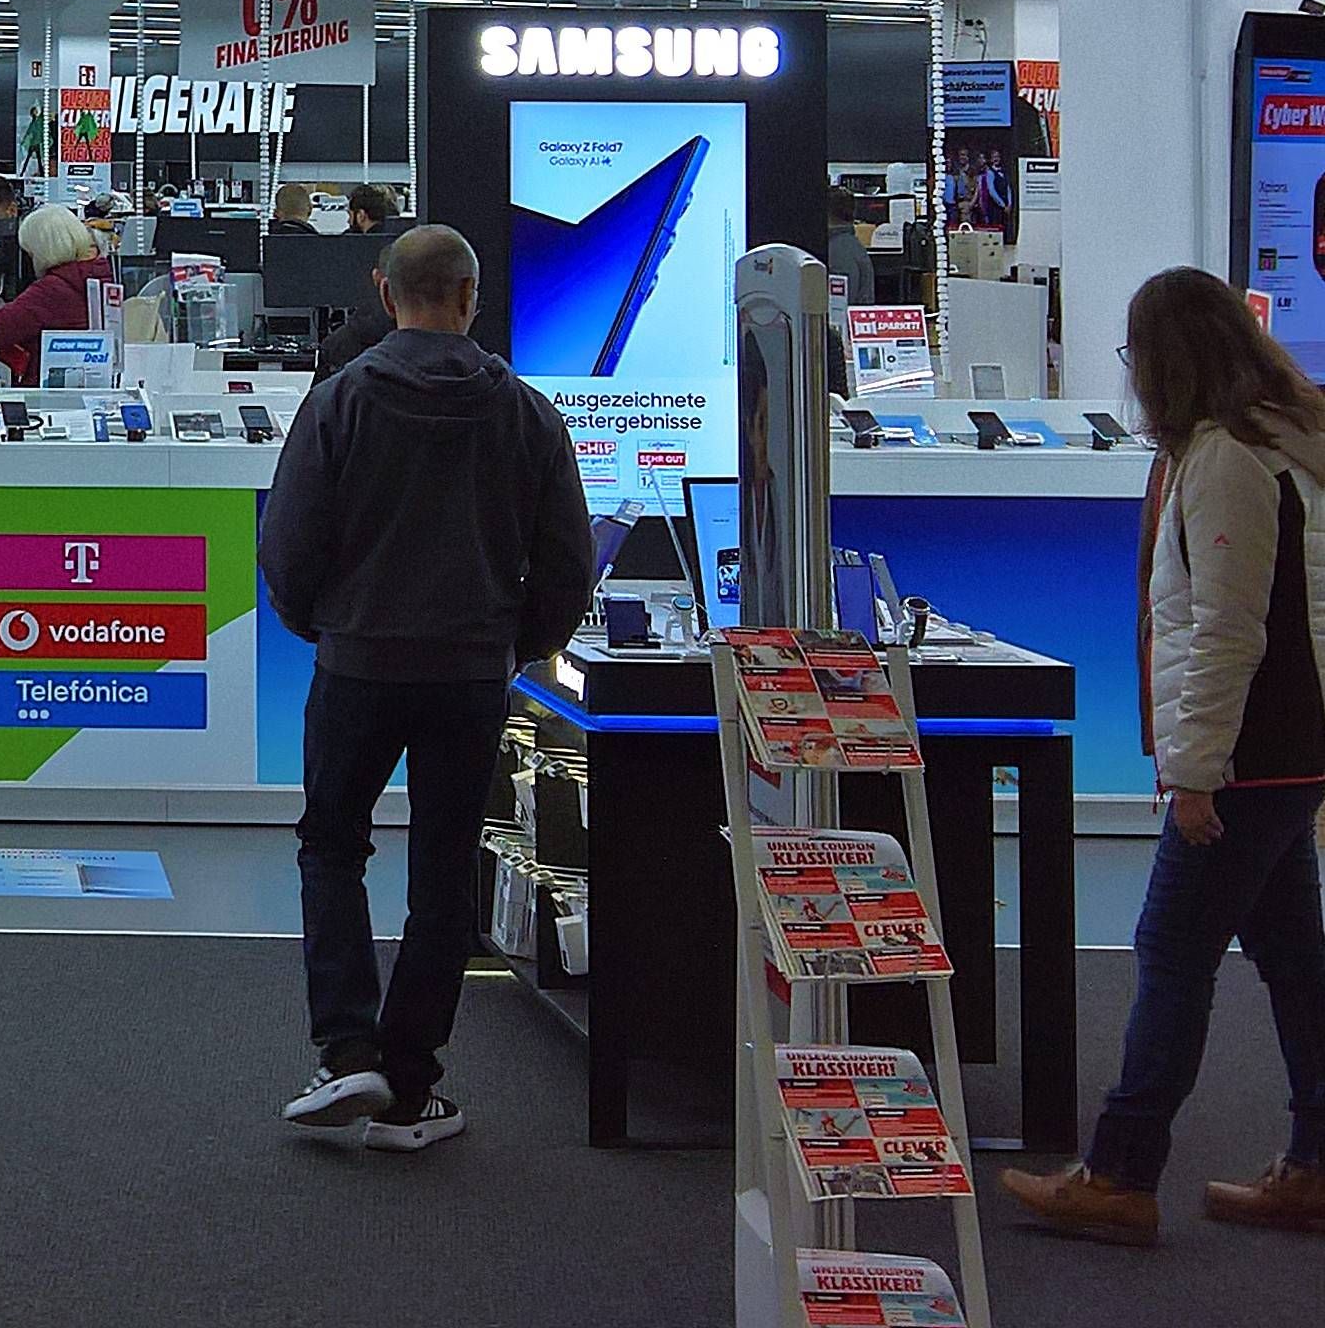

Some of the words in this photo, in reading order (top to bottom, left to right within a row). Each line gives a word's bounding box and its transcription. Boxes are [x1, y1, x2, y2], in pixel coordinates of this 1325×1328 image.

[481, 25, 780, 77] SAMSUNG
[1265, 103, 1309, 130] Cyber
[539, 142, 583, 154] Galaxy
[583, 142, 590, 152] Z
[592, 142, 623, 153] Fold7
[549, 156, 588, 167] Galaxy
[83, 352, 109, 364] Deal
[553, 391, 707, 412] Ausgezeichnete
[575, 442, 617, 455] CHIP
[65, 542, 100, 583] T
[49, 620, 166, 644] vodafone
[16, 679, 149, 703] Telefónica
[821, 841, 876, 851] COUPON
[773, 851, 876, 865] KLASSIKER!
[864, 923, 926, 937] CLEVER
[792, 1062, 897, 1077] KLASSIKER!
[883, 1141, 948, 1154] CLEVER
[817, 1276, 923, 1292] KLASSIKER!
